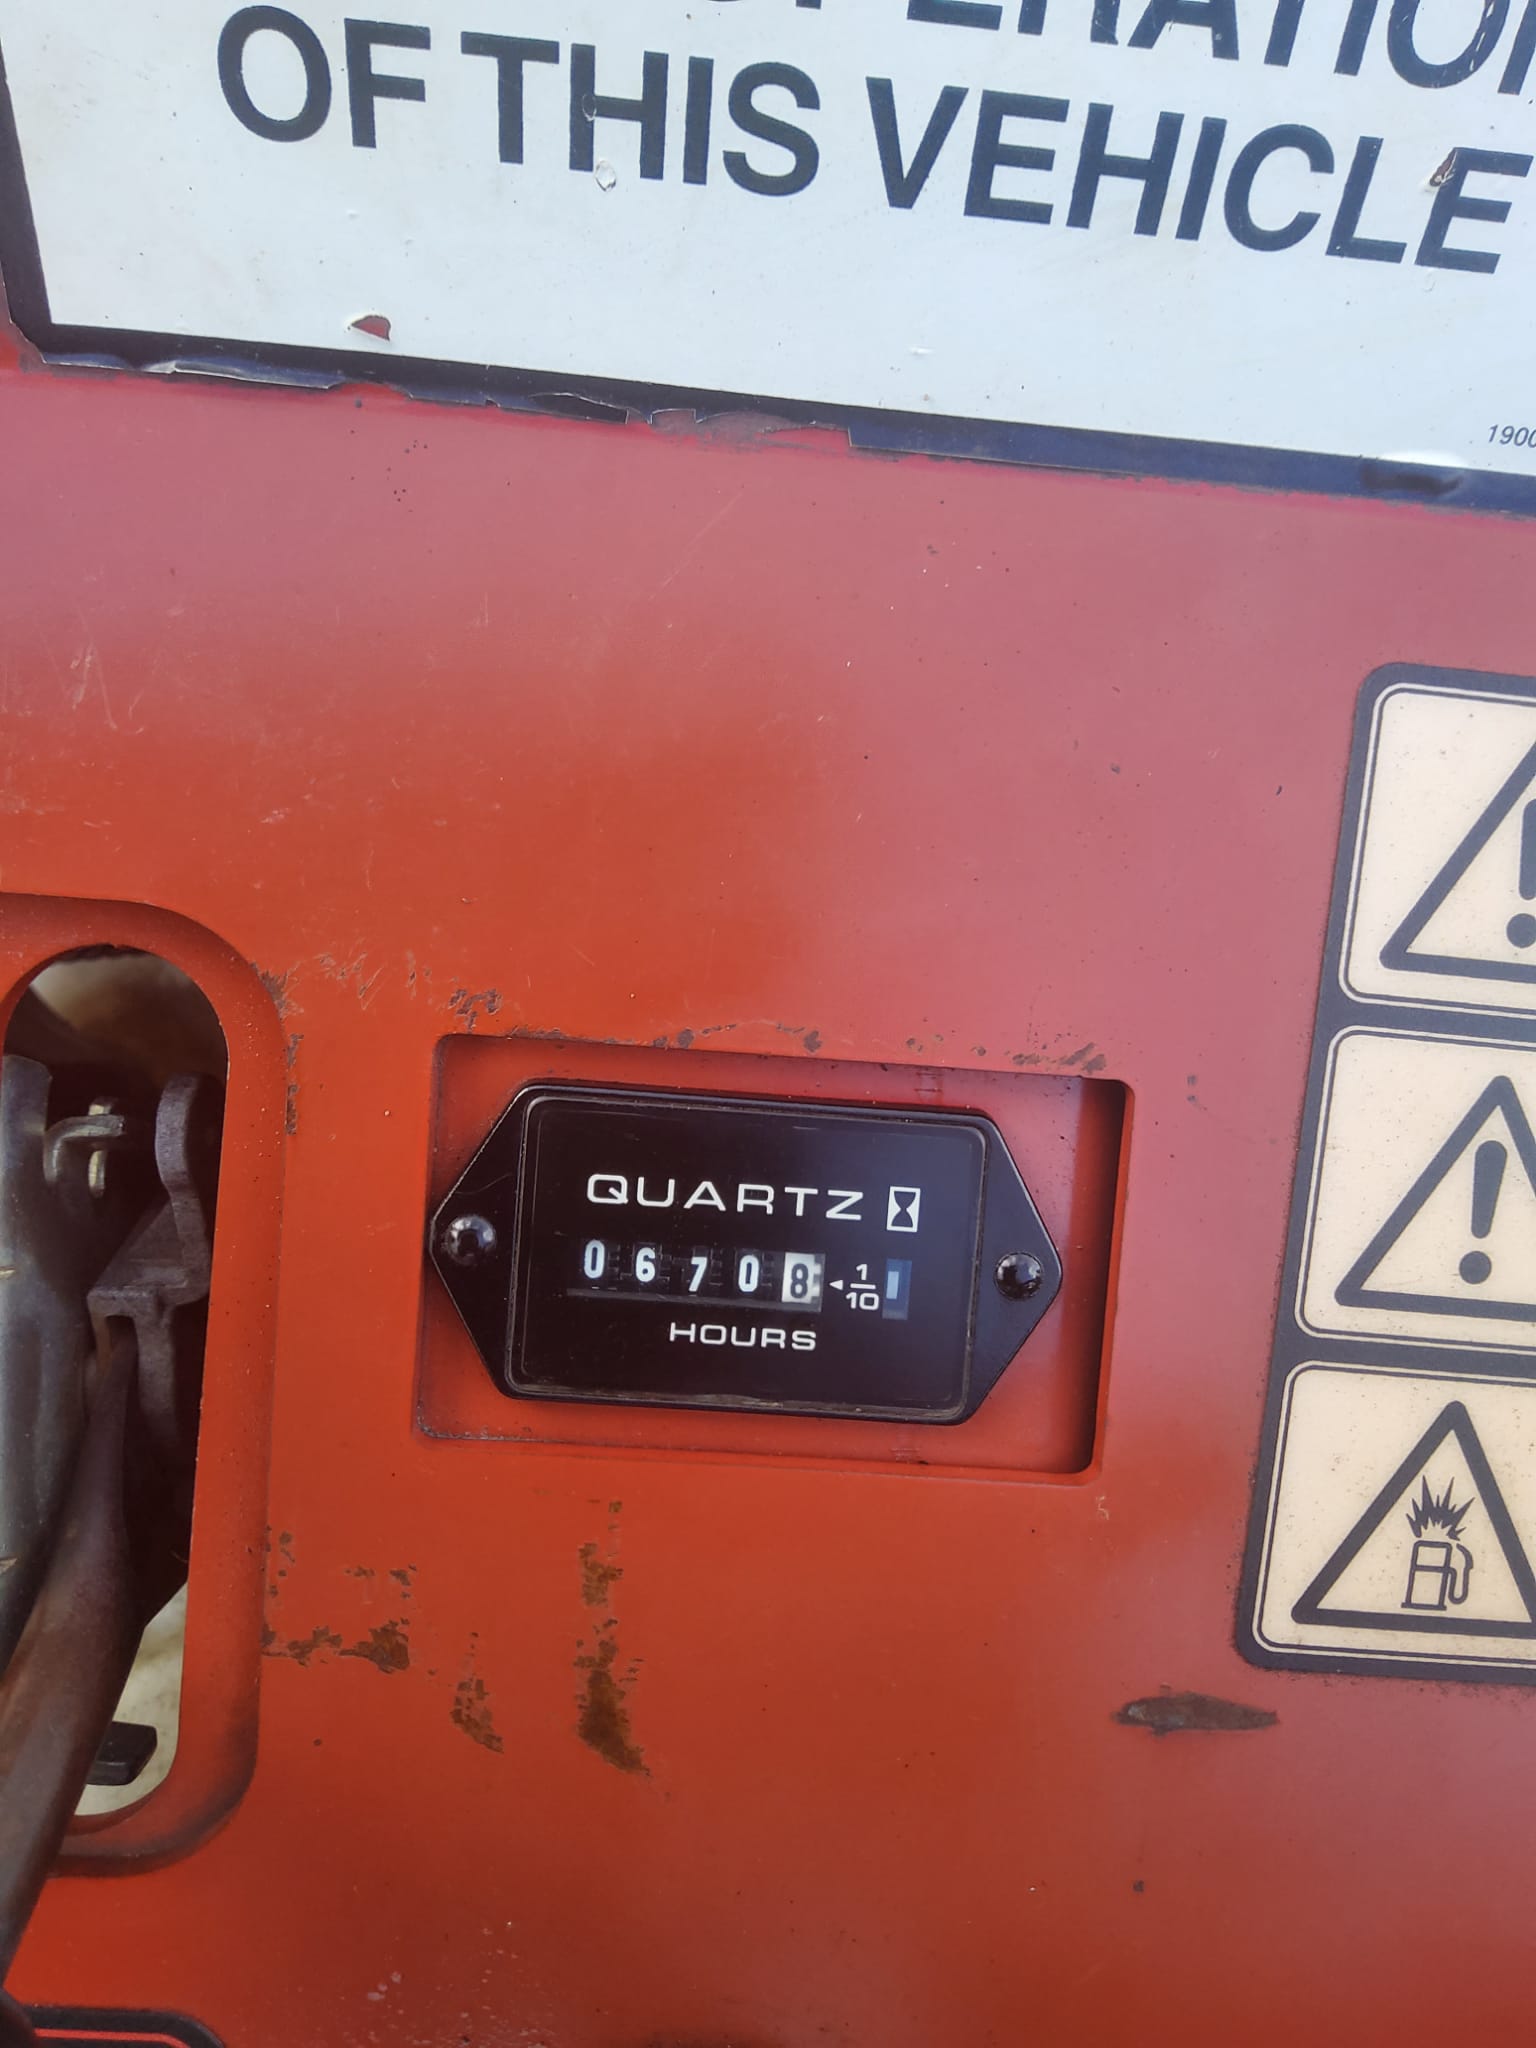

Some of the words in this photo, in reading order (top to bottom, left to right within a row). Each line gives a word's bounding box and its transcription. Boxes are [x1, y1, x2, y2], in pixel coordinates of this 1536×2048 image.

[217, 4, 431, 149] OF
[460, 30, 820, 197] THIS
[865, 76, 1534, 274] VEHICLE
[586, 1172, 864, 1221] QUARTZ
[669, 1321, 818, 1351] HOURS
